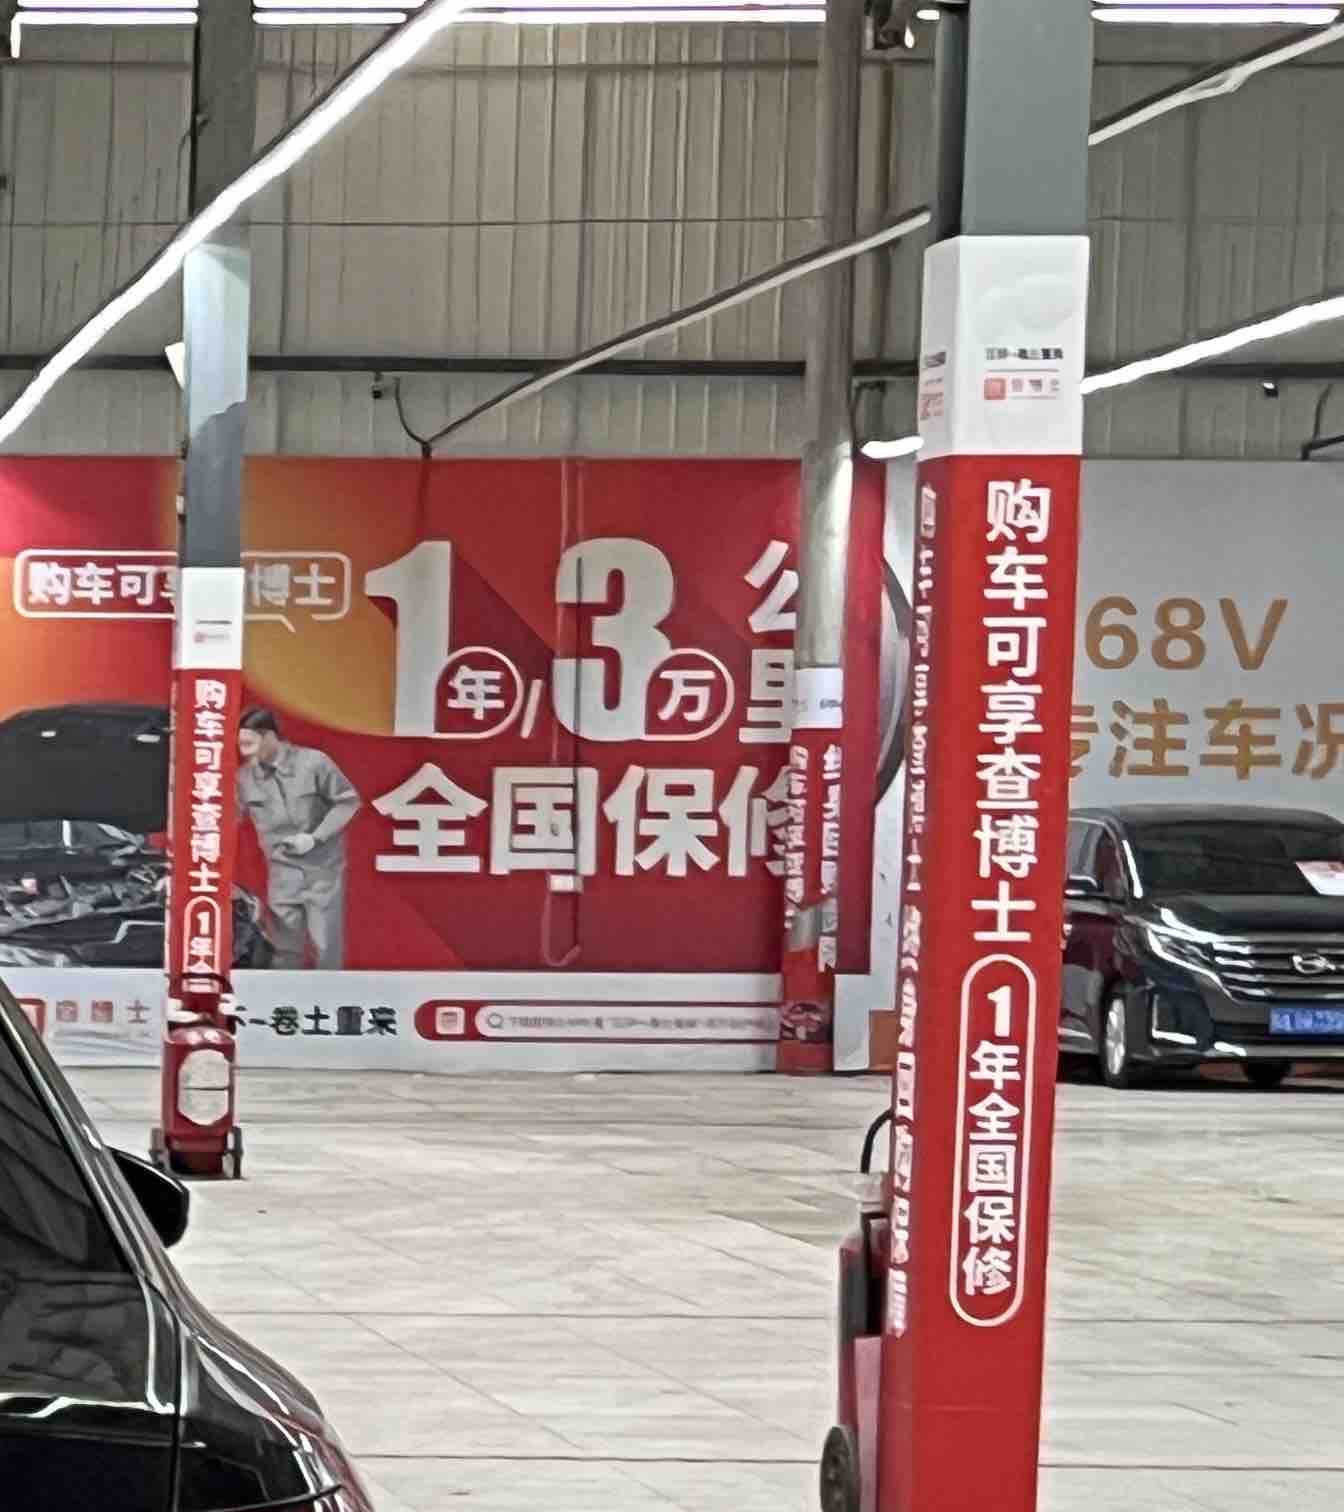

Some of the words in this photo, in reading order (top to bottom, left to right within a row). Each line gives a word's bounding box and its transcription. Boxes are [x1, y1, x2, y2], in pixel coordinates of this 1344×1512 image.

[27, 561, 336, 607] 购车可博士
[1084, 596, 1289, 671] 68V
[971, 478, 1051, 942] 购车可享查博士
[963, 986, 1021, 1297] 1年全国保修
